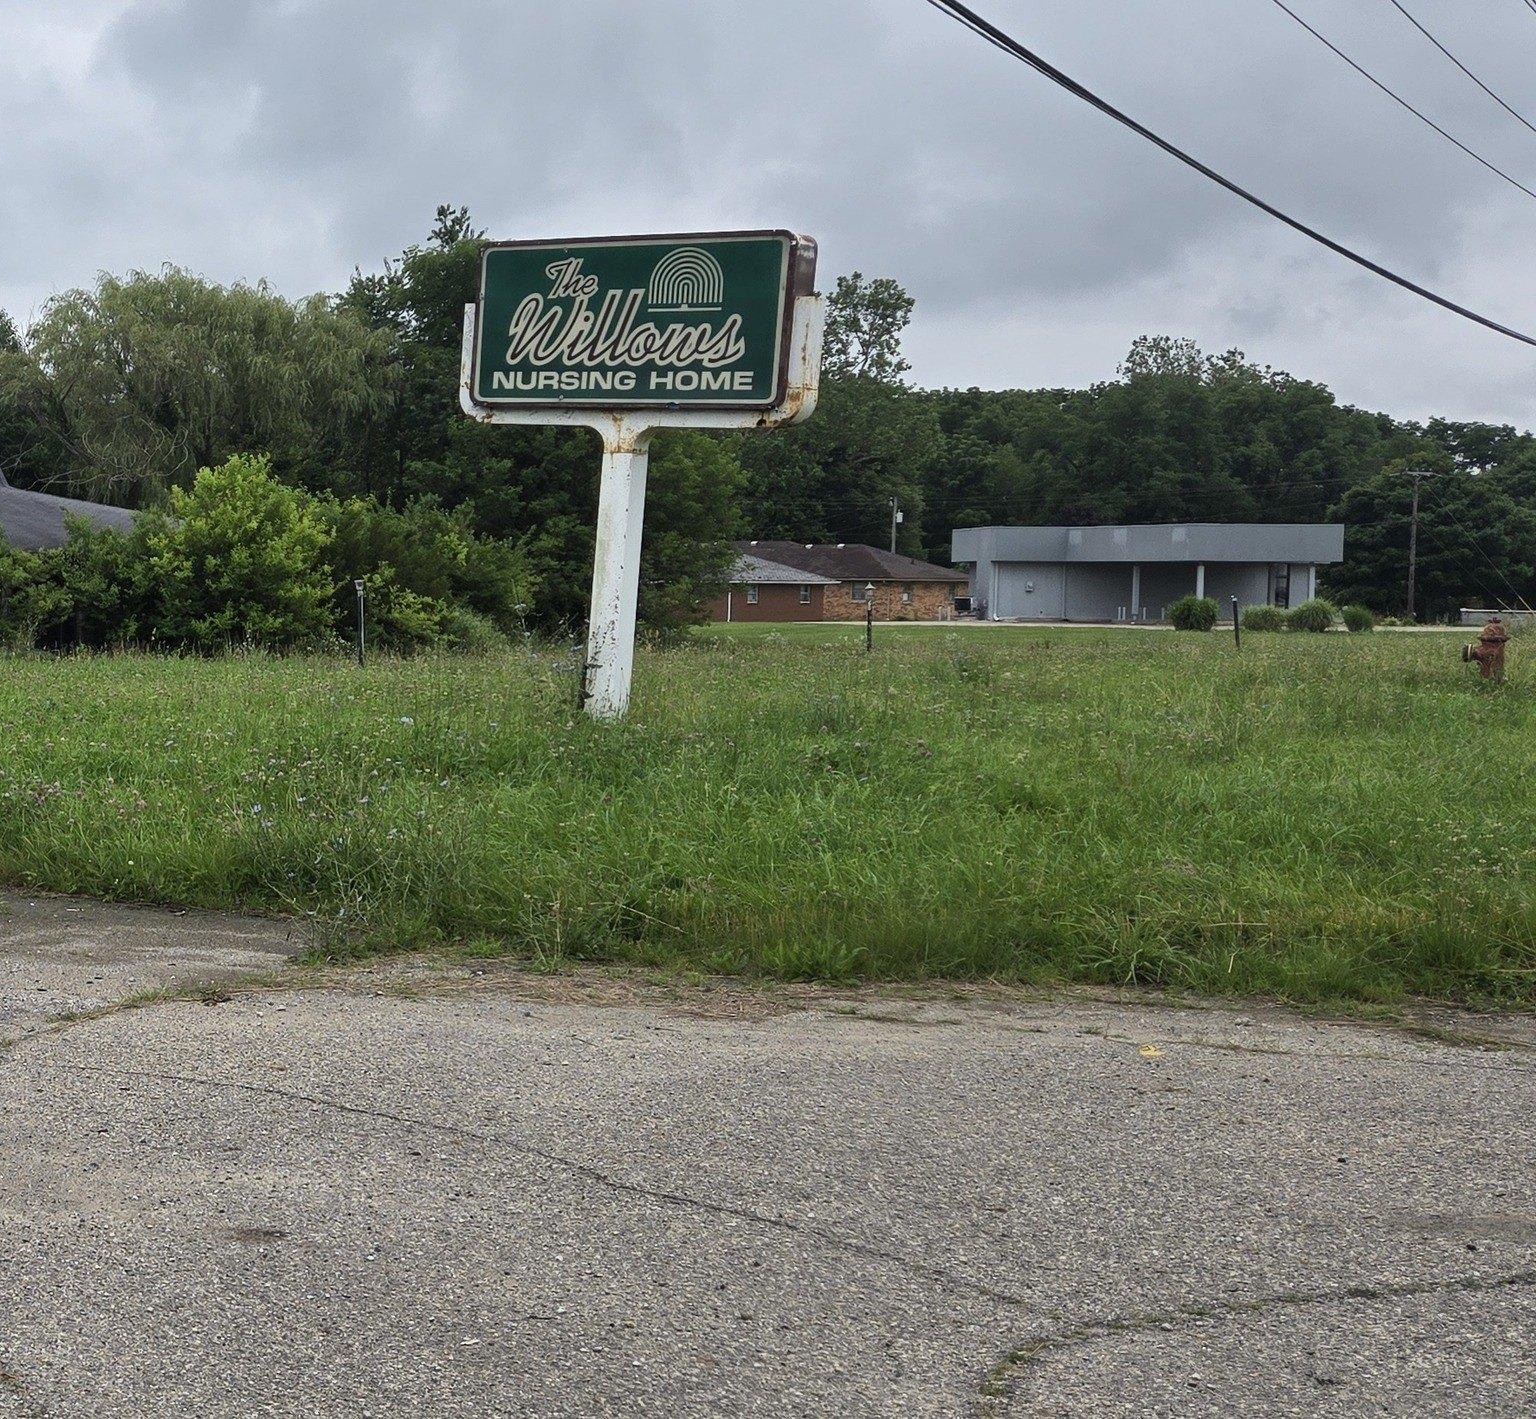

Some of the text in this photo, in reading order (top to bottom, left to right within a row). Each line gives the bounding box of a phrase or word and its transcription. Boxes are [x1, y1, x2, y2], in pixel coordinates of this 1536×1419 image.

[546, 257, 599, 299] The
[506, 289, 746, 367] Willows
[492, 371, 754, 390] NURSING HOME
